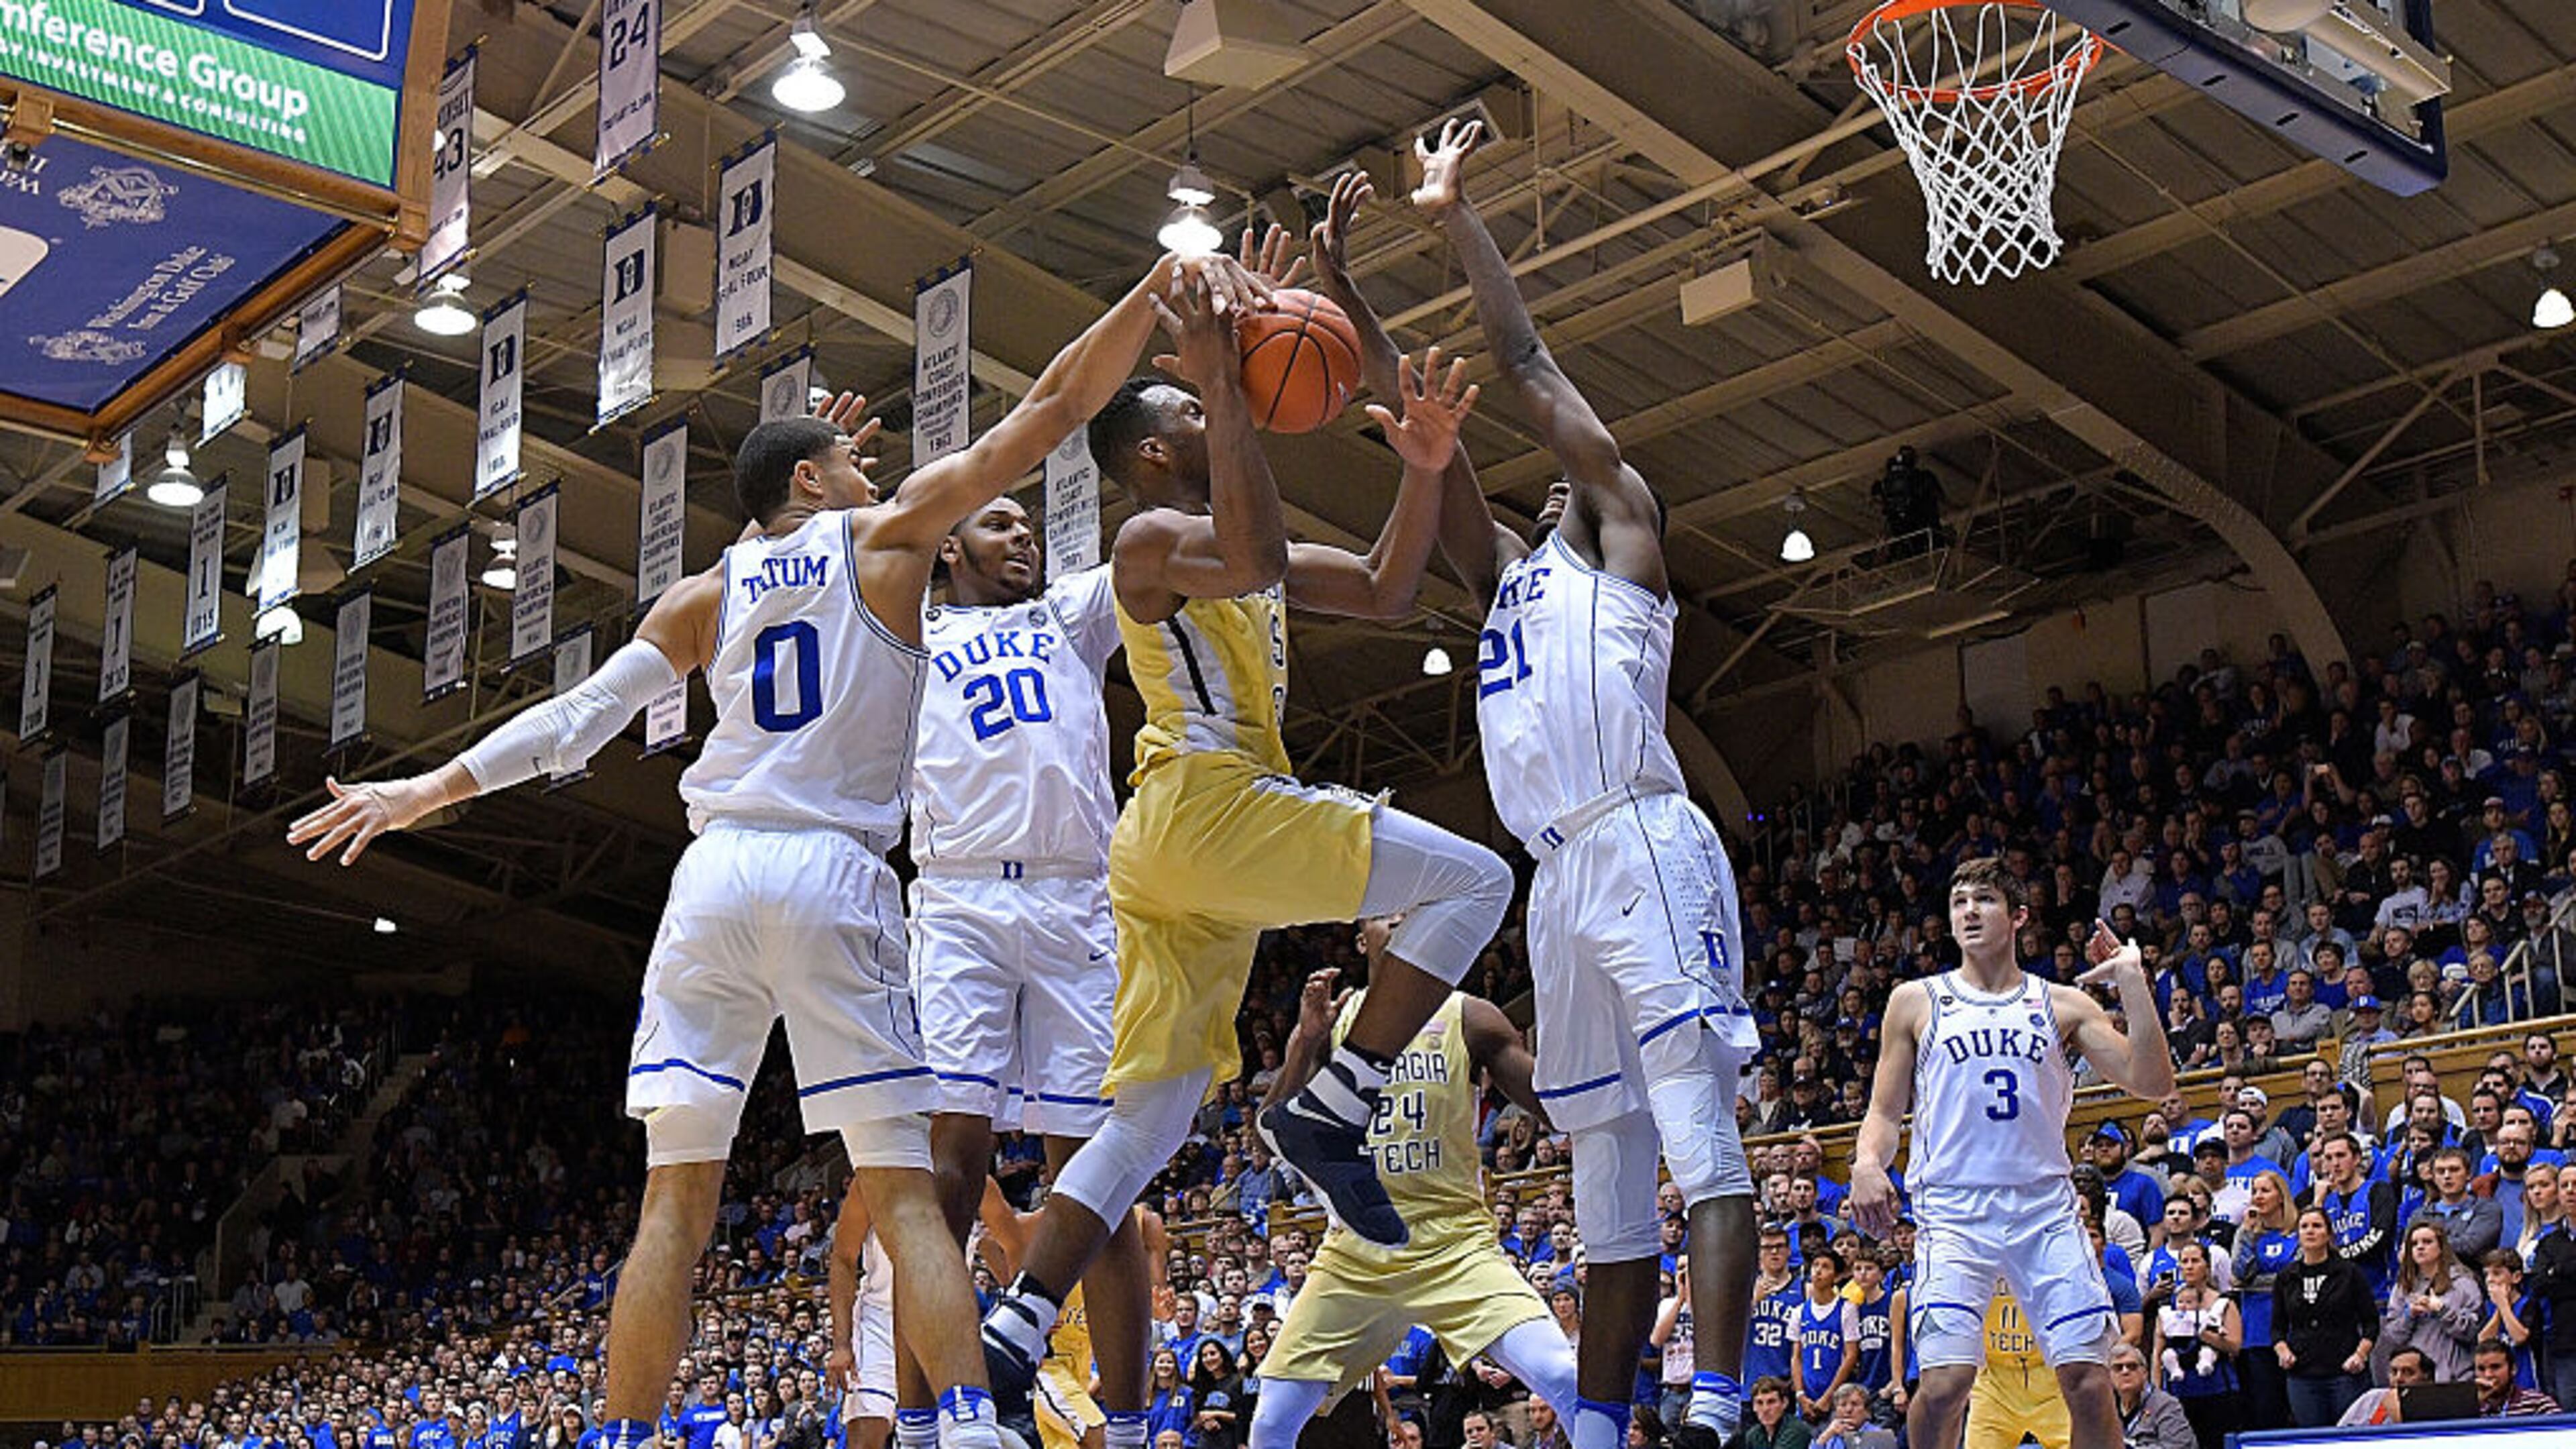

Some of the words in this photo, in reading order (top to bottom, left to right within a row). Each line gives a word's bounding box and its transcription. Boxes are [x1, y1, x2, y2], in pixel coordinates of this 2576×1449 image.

[609, 2, 649, 70] 24
[0, 0, 178, 77] nference
[188, 54, 308, 119] Group
[915, 372, 965, 405] CONFERENCE
[928, 362, 955, 385] COAST
[916, 389, 964, 421] CHAMPIONS
[1497, 569, 1552, 609] KE
[932, 631, 1055, 682] DUKE
[1479, 619, 1533, 702] 21
[752, 621, 823, 733] 0
[963, 667, 1052, 742] 20
[1942, 1028, 2048, 1065] DUKE
[1373, 1091, 1425, 1135] 24
[1984, 1068, 2019, 1122] 3
[1370, 1140, 1441, 1173] TECH
[1753, 1322, 1782, 1348] 32
[1858, 1314, 1890, 1338] UKE
[2002, 1304, 2017, 1330] 11
[1812, 1347, 1822, 1370] 1
[1990, 1330, 2036, 1352] TECH
